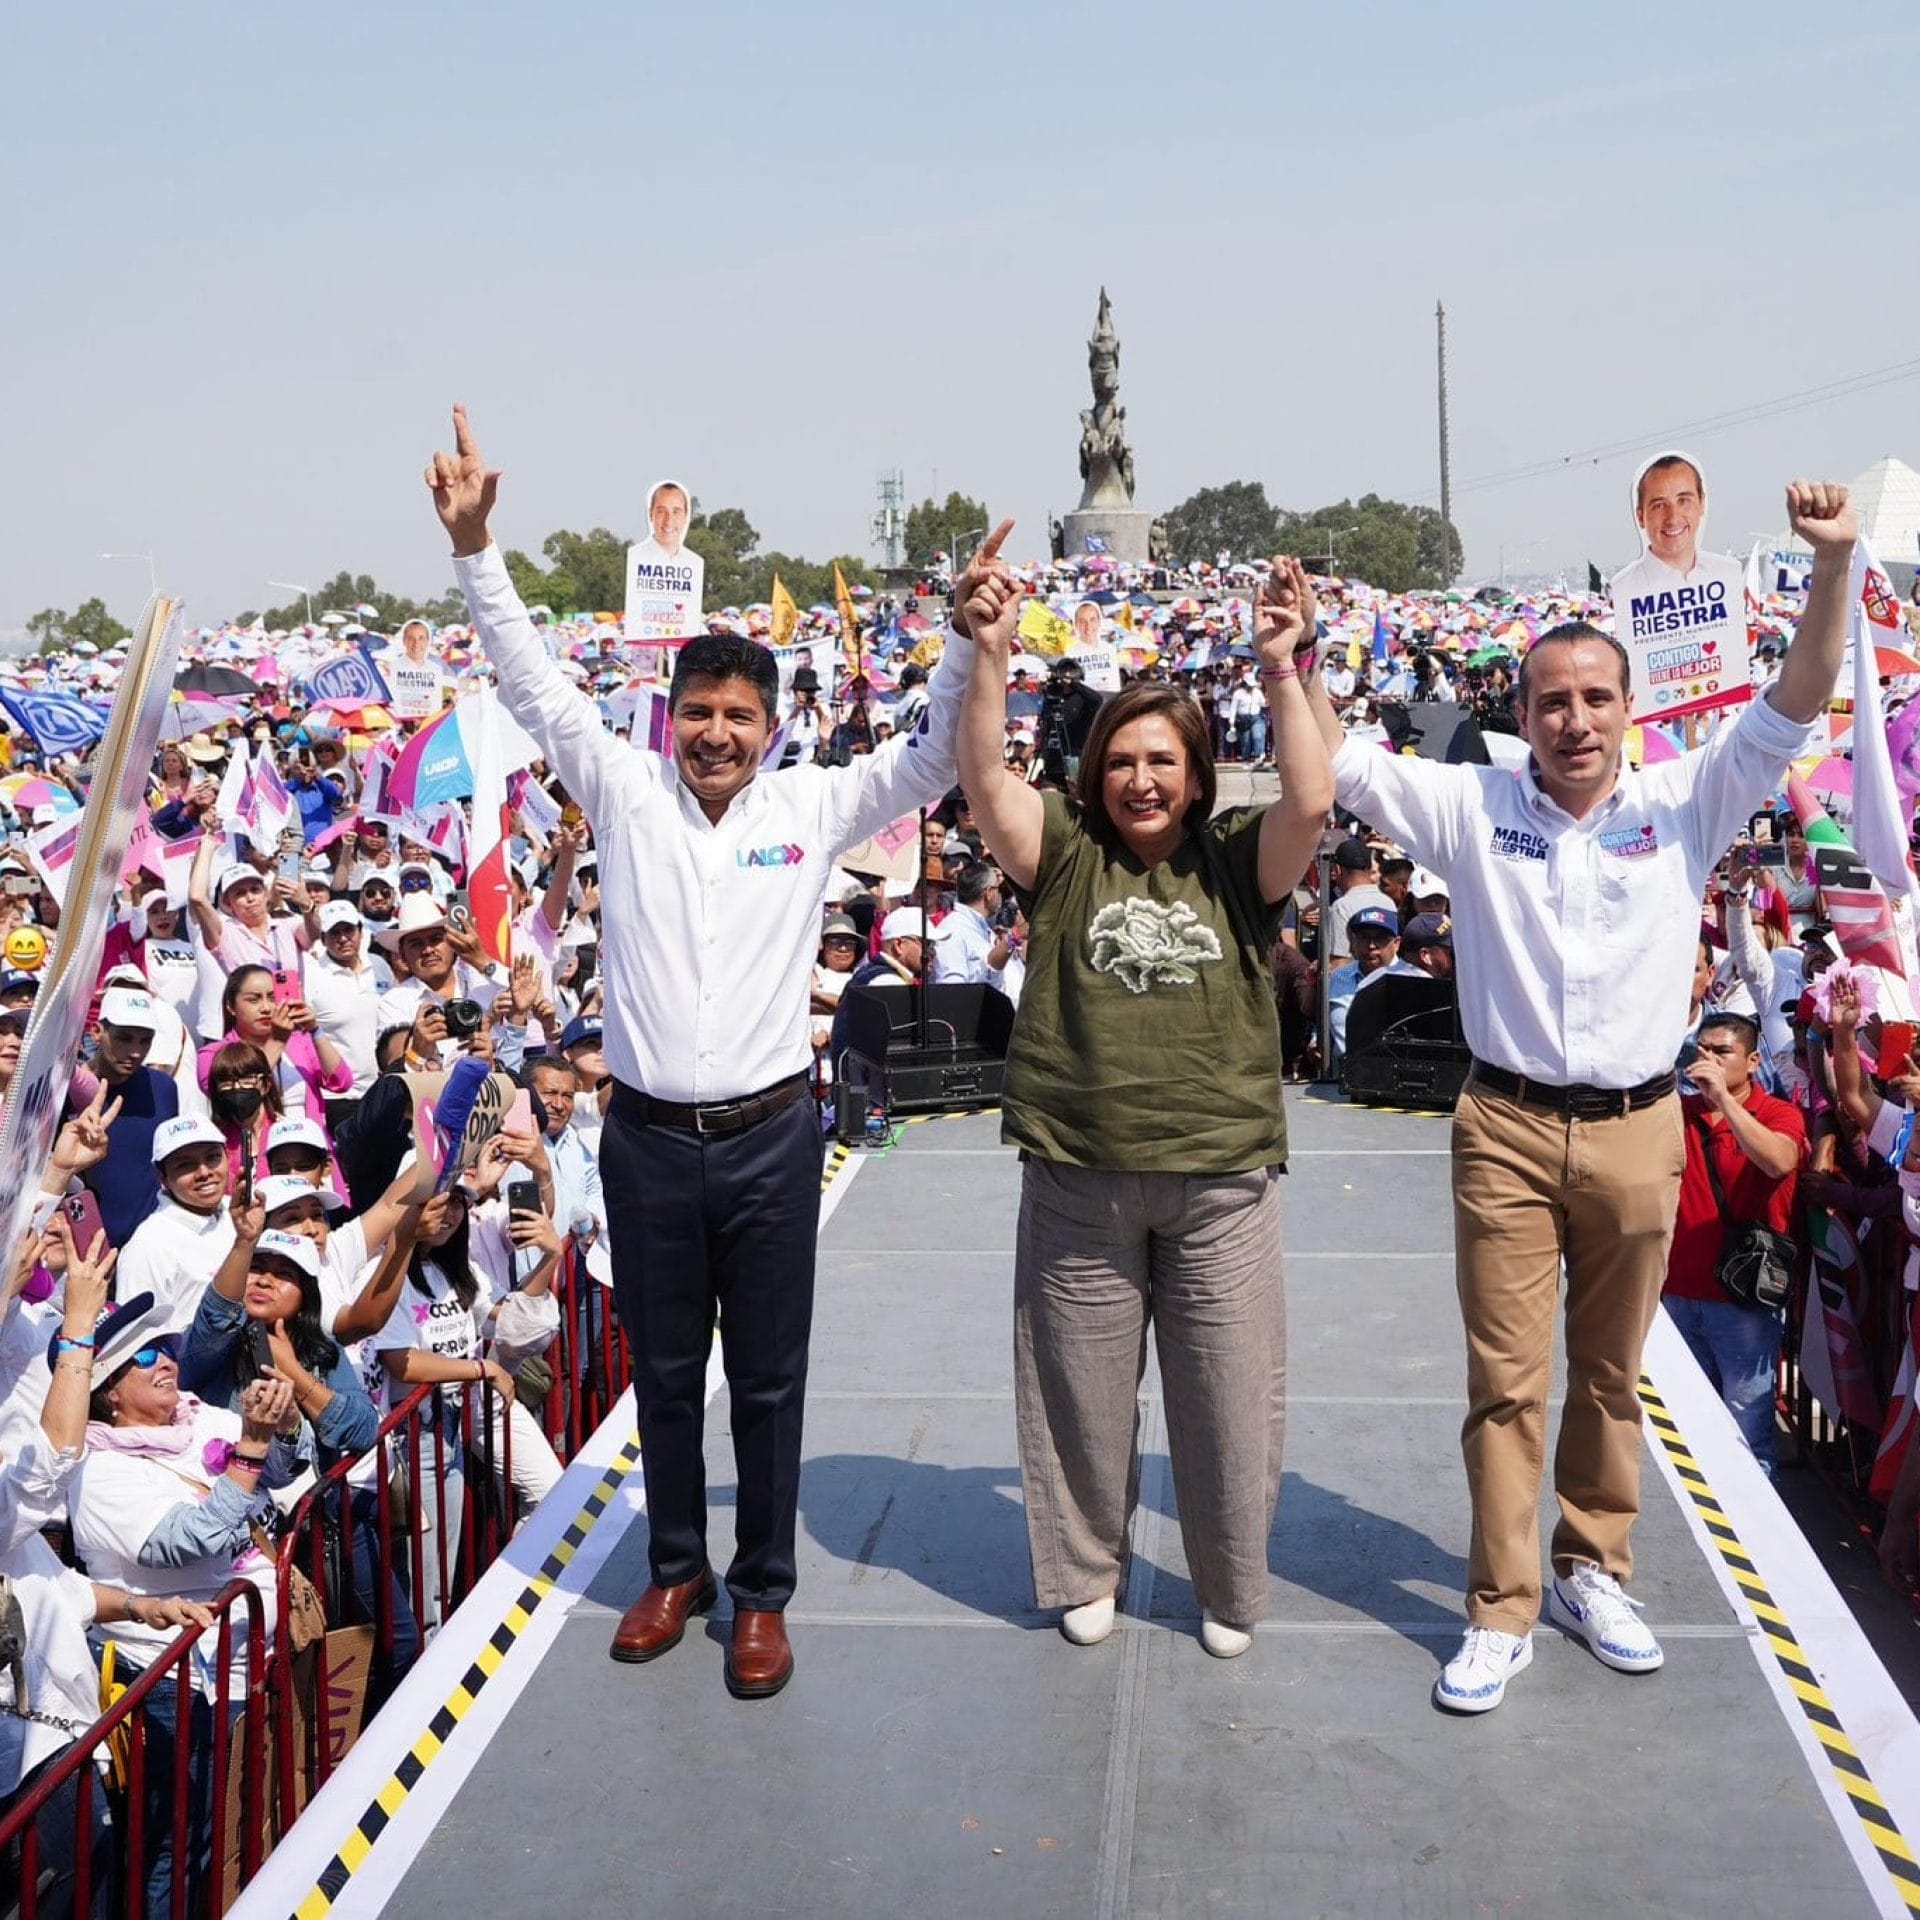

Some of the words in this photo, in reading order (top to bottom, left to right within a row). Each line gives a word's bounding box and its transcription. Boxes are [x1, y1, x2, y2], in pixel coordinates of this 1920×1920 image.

[637, 564, 693, 579] MARIO
[636, 578, 692, 592] RIESTRA
[1630, 580, 1725, 618] MARIO
[1632, 602, 1728, 638] RIESTRA
[1648, 644, 1700, 669] CONTIGO
[397, 671, 435, 680] MARIO
[1681, 657, 1721, 678] MEJOR
[1493, 827, 1550, 850] MARIO
[1490, 840, 1546, 860] RIESTRA
